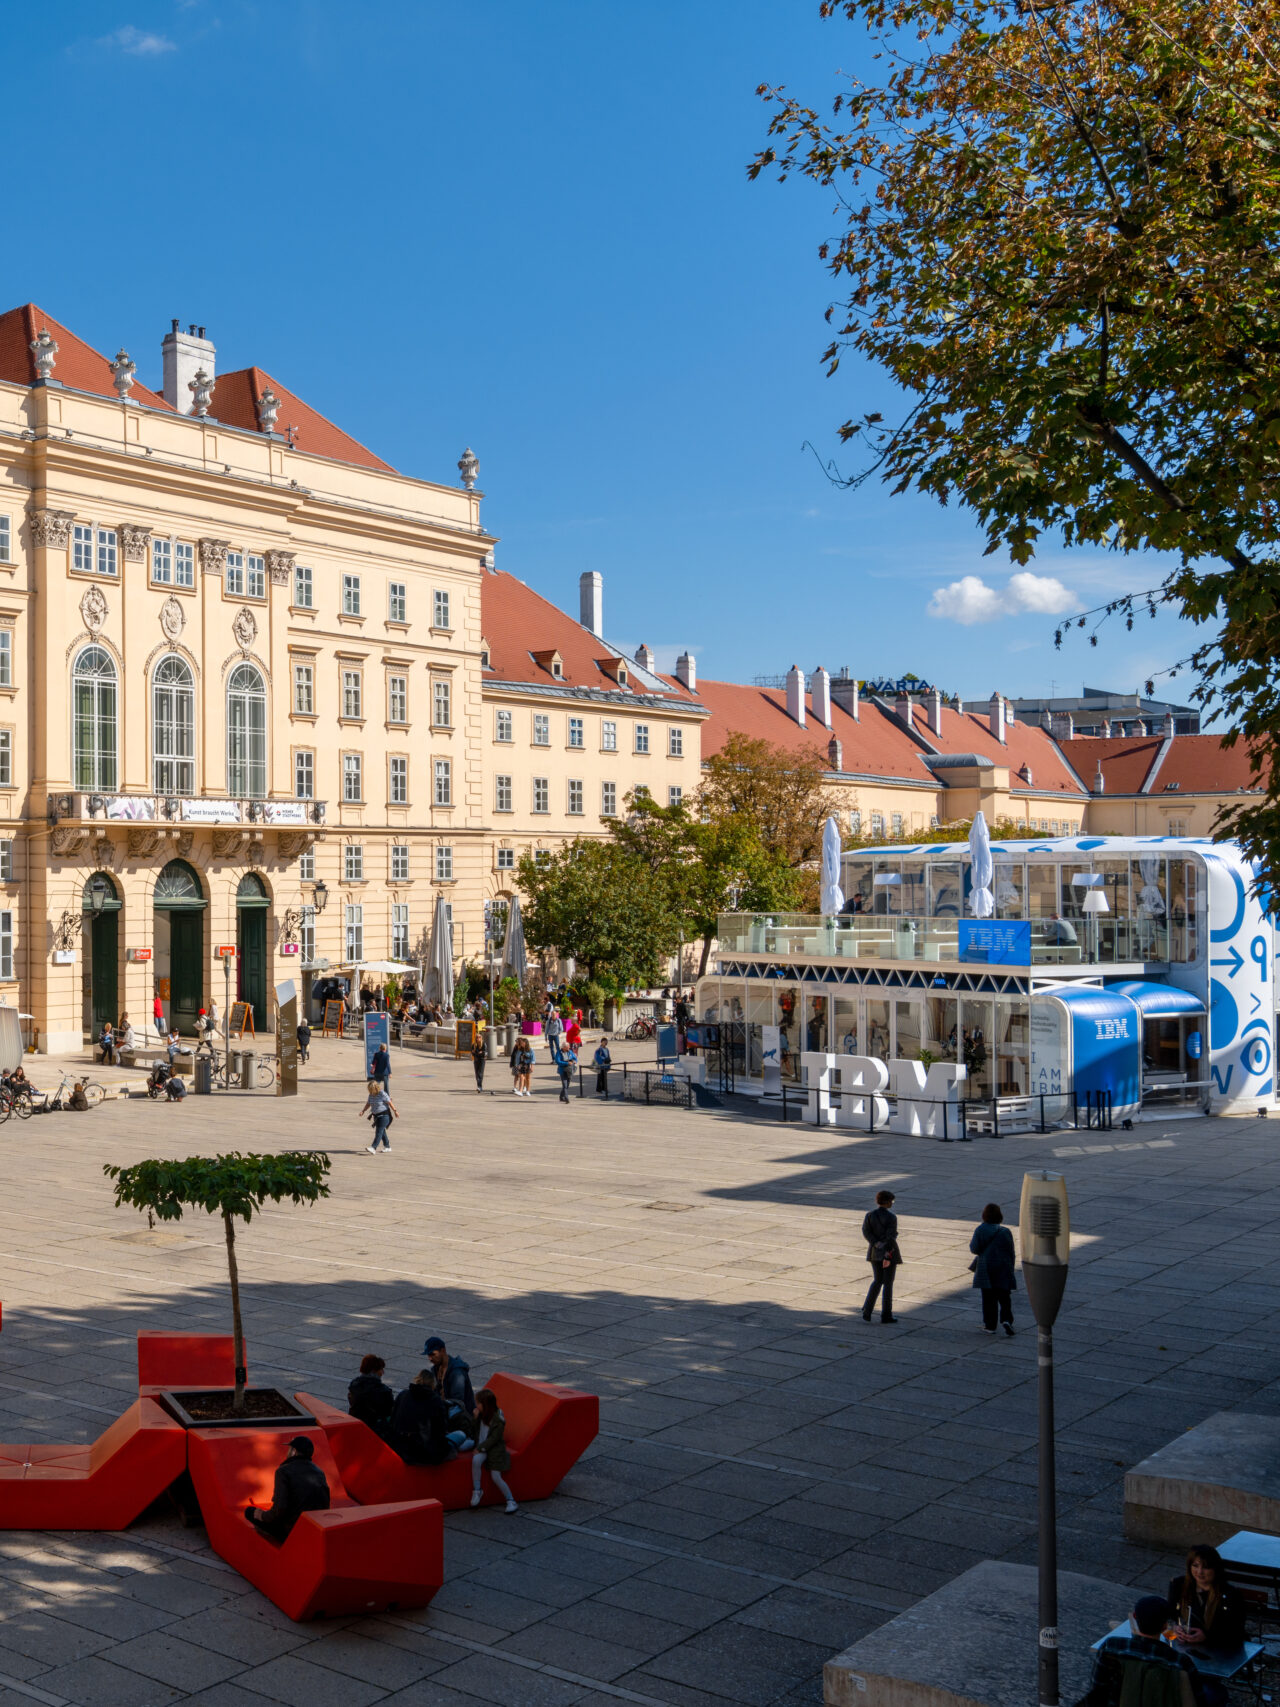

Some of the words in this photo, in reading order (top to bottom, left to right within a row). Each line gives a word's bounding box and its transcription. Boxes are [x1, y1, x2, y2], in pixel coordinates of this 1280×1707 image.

[870, 679, 931, 691] VARTA
[967, 927, 1017, 952] IBM
[1094, 1018, 1130, 1040] IBM
[800, 1051, 967, 1140] IBM
[1031, 1081, 1062, 1095] IBM
